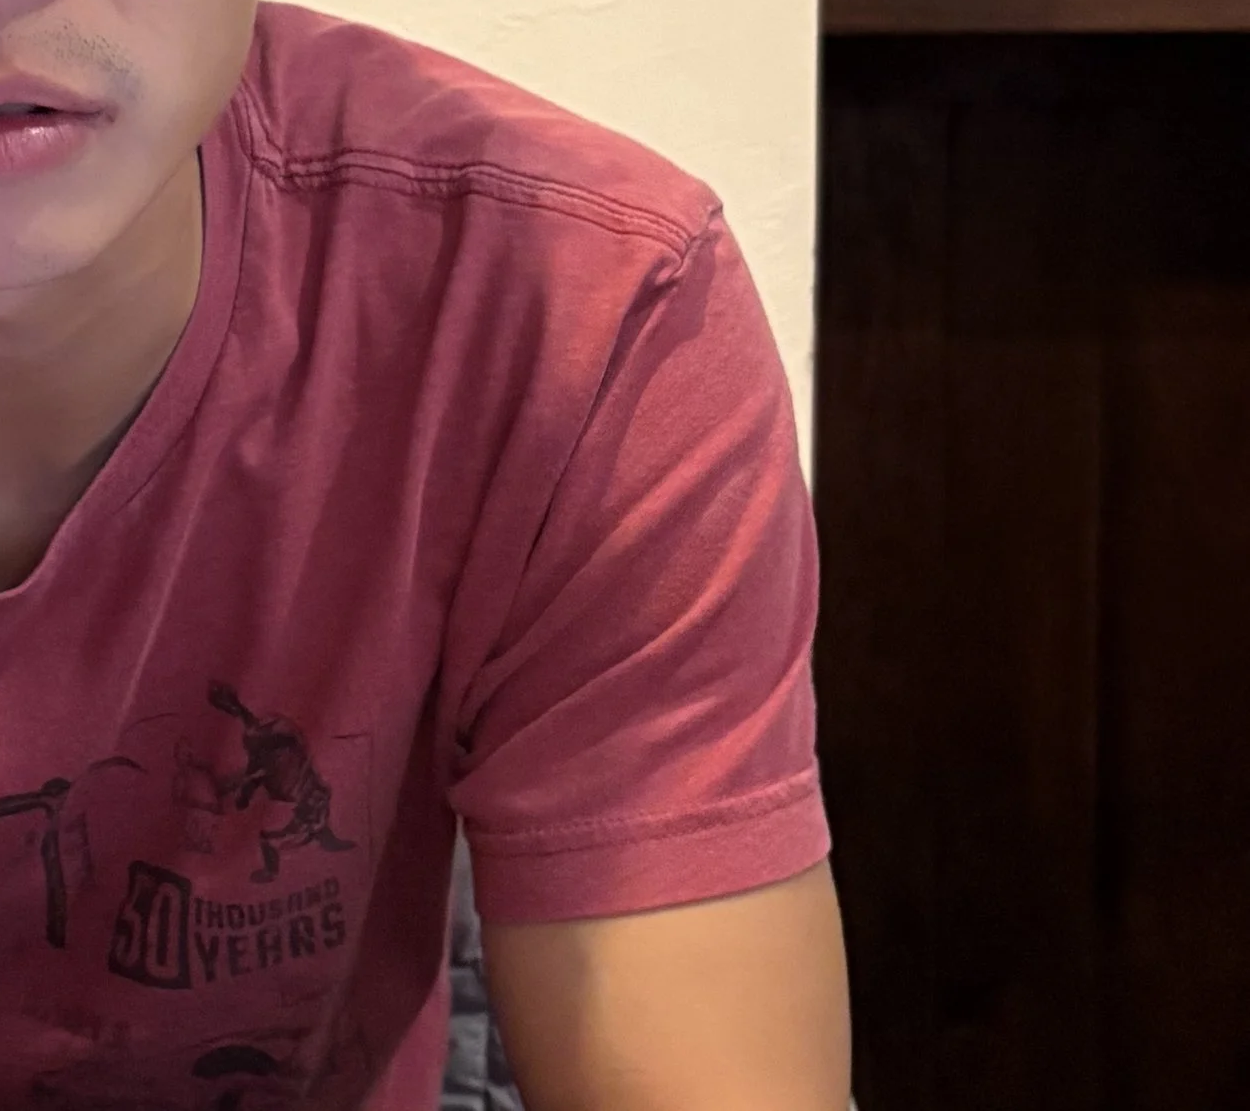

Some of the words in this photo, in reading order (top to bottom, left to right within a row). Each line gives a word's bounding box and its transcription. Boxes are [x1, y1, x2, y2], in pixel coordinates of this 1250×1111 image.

[111, 869, 185, 982] 50
[194, 876, 340, 929] THOUSAND
[194, 902, 347, 982] YEARS
